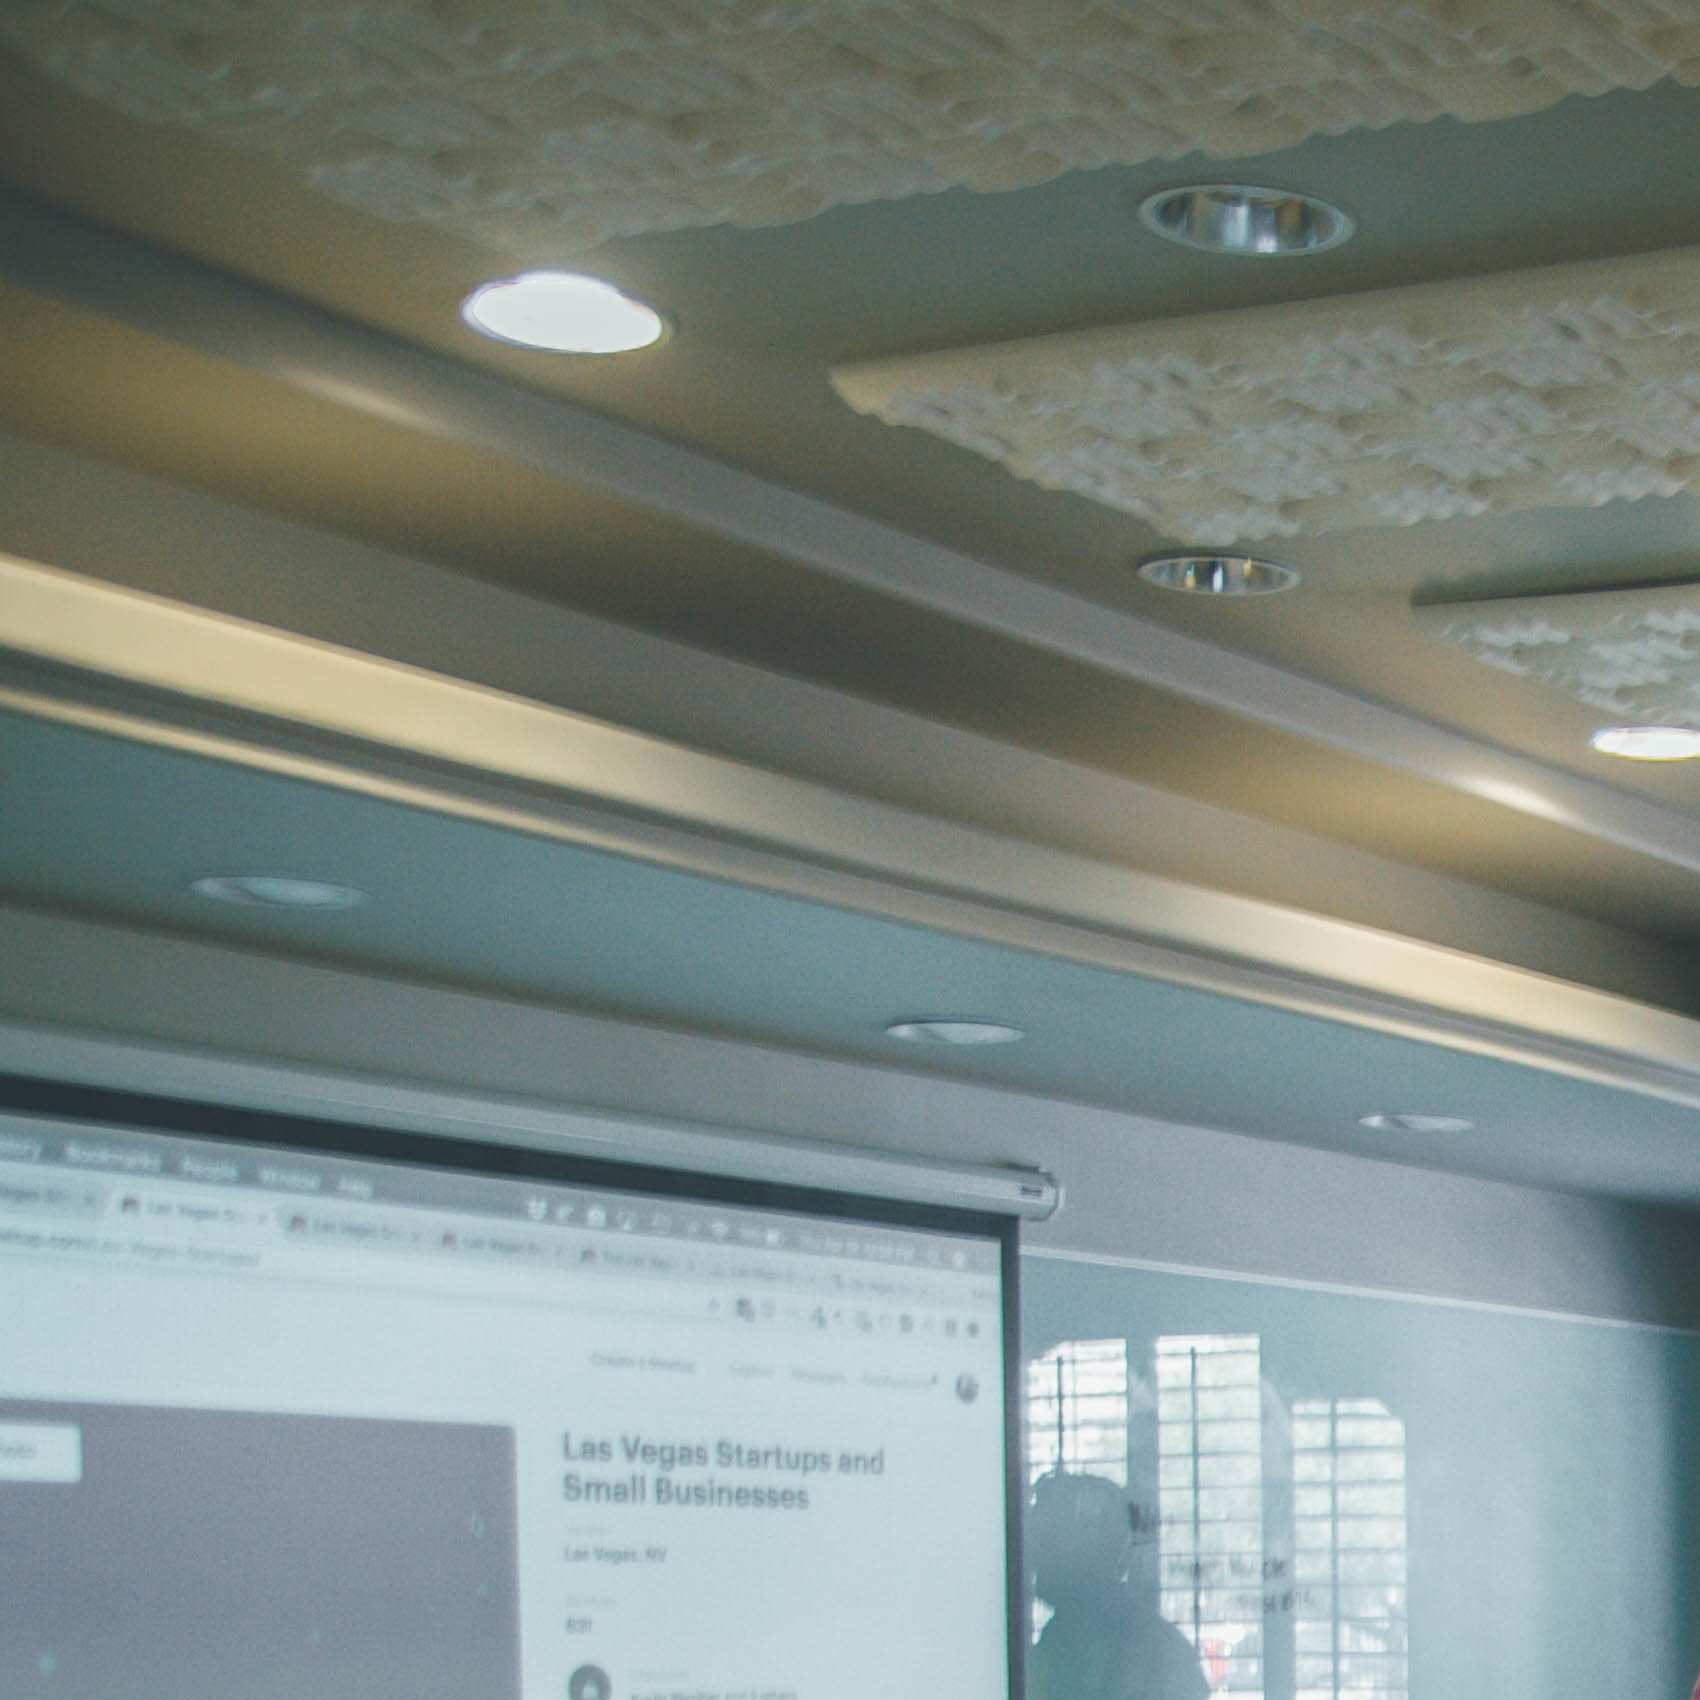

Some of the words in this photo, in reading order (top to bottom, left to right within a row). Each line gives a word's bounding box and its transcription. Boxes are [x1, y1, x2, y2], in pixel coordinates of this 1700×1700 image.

[562, 1433, 613, 1464] Las
[621, 1436, 709, 1472] Vegas
[714, 1440, 832, 1476] Startups
[837, 1448, 885, 1475] and
[562, 1473, 646, 1505] Small
[654, 1477, 810, 1510] Businesses
